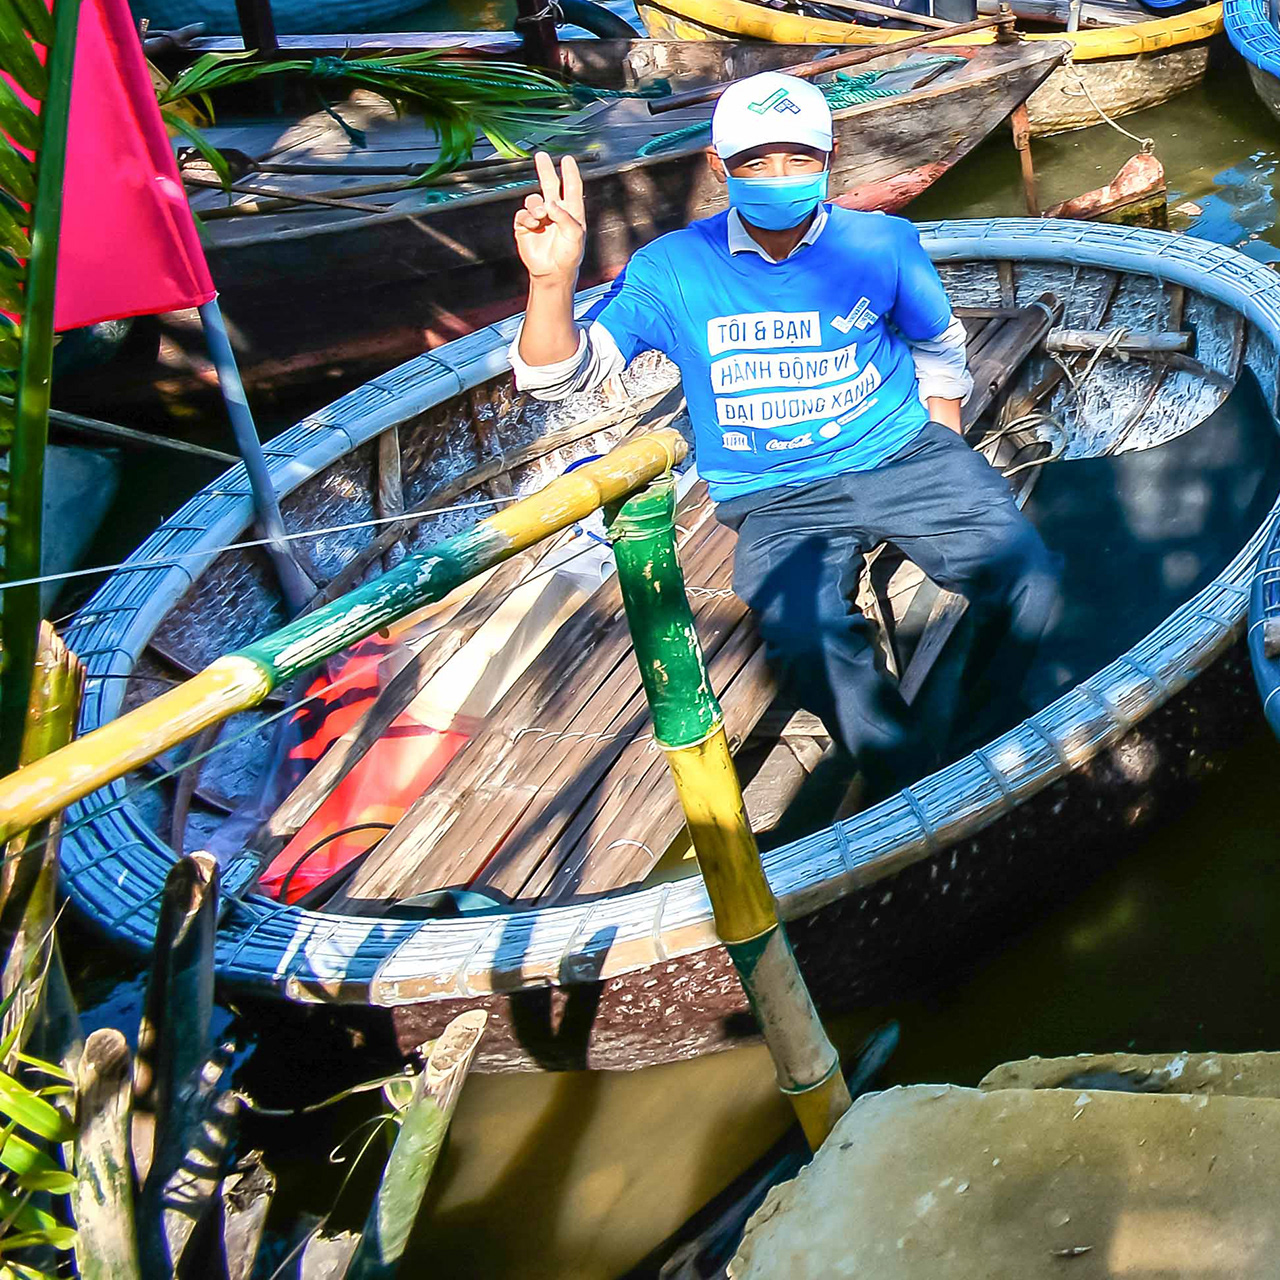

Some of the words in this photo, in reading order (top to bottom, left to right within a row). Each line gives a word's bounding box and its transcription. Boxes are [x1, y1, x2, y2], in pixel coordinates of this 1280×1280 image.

[717, 318, 747, 344] TÔI
[754, 325, 766, 341] &
[773, 319, 812, 344] BẠN
[721, 358, 772, 387] HÀNH
[779, 356, 829, 384] ĐỘNG
[834, 348, 850, 372] VÌ
[725, 402, 754, 424] ĐẠI
[831, 373, 876, 410] XANH
